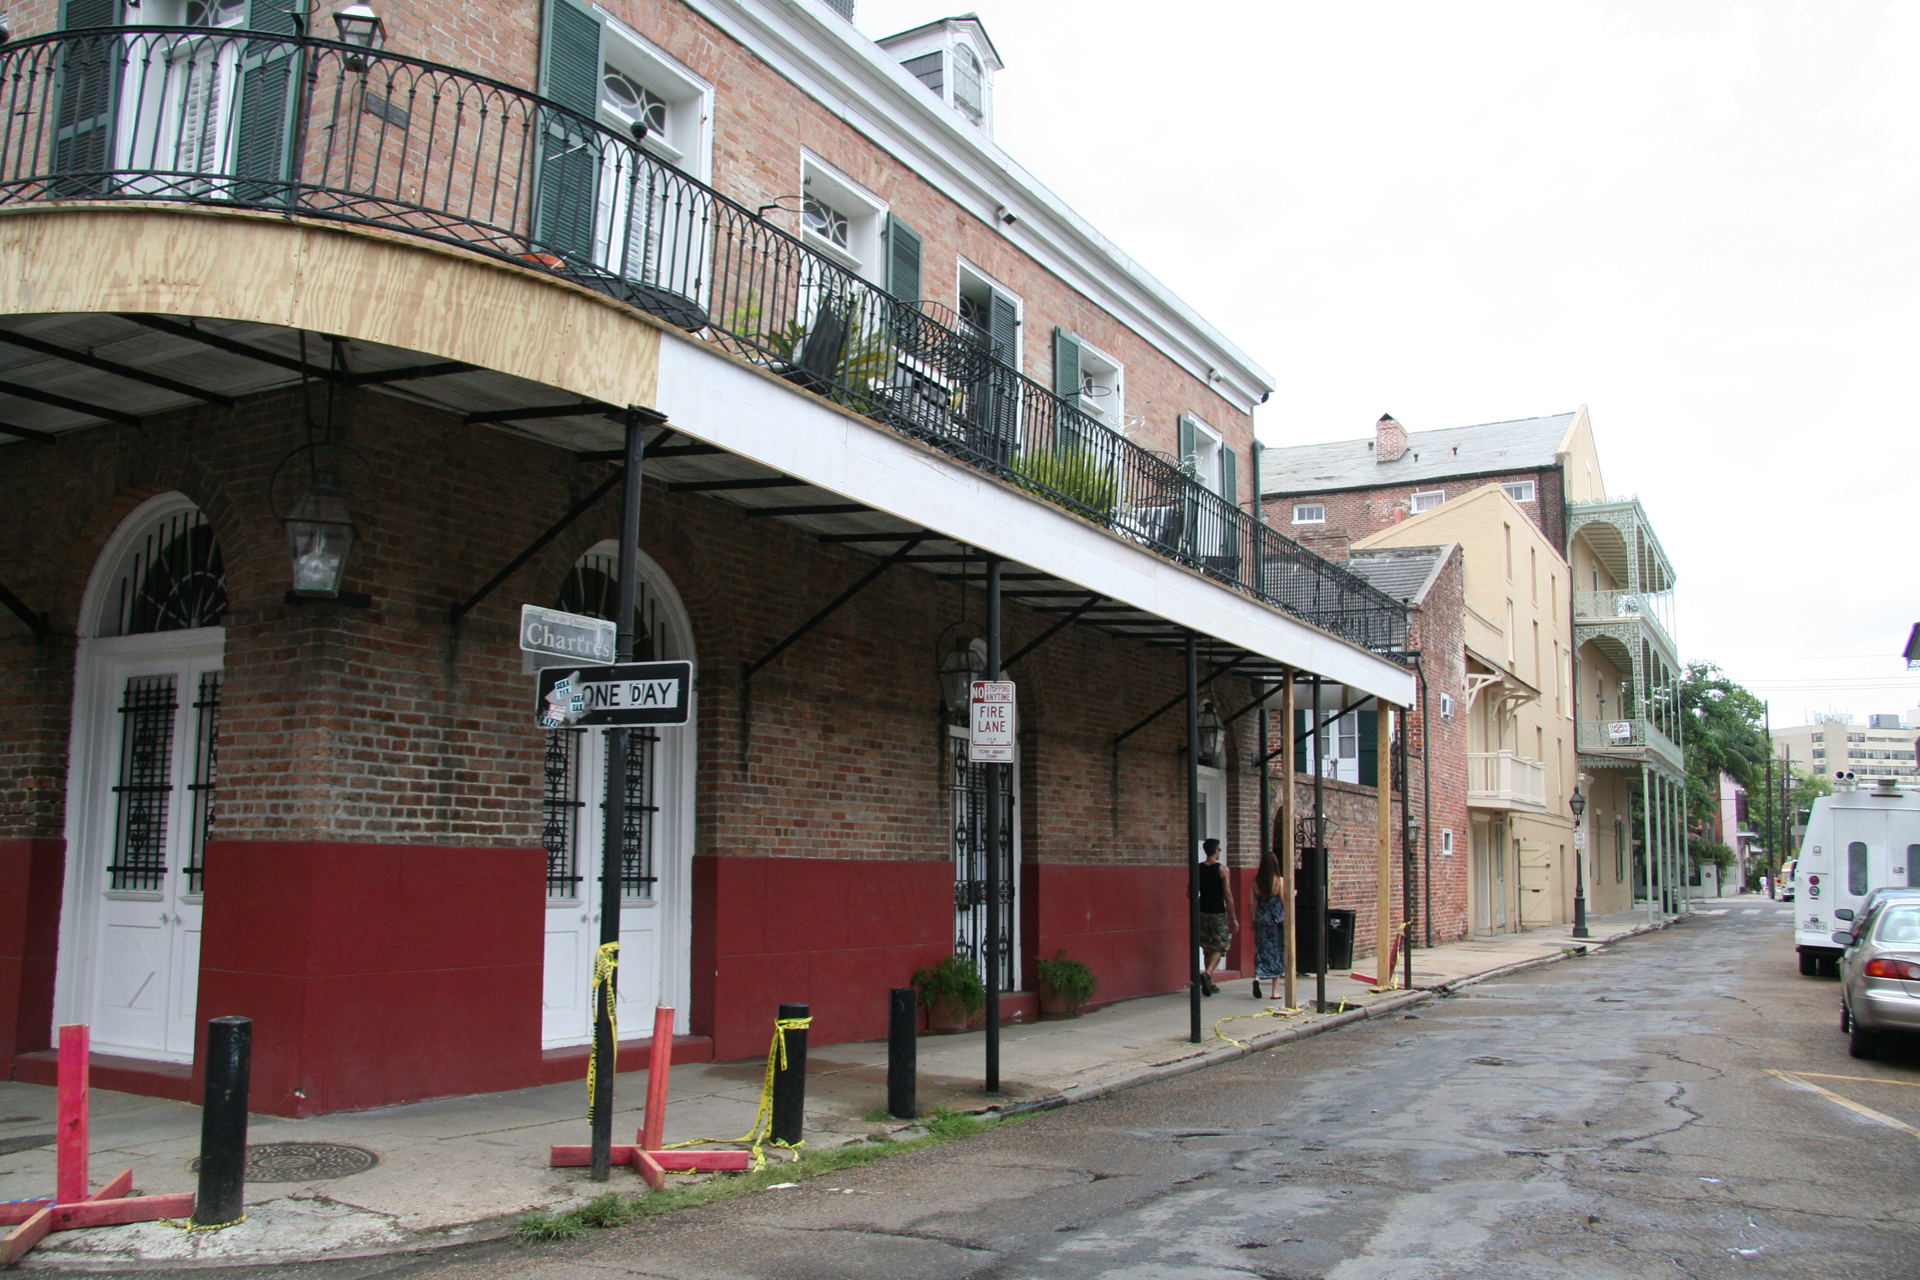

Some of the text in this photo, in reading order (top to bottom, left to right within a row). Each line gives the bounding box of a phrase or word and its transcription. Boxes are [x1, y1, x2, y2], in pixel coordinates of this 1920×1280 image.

[526, 622, 610, 658] Chartres
[972, 687, 984, 699] NO
[986, 684, 1010, 692] STOPPING
[583, 684, 620, 707] ONE
[986, 693, 1010, 701] ANYTIME
[980, 706, 1005, 718] FIRE
[978, 721, 1006, 733] LANE
